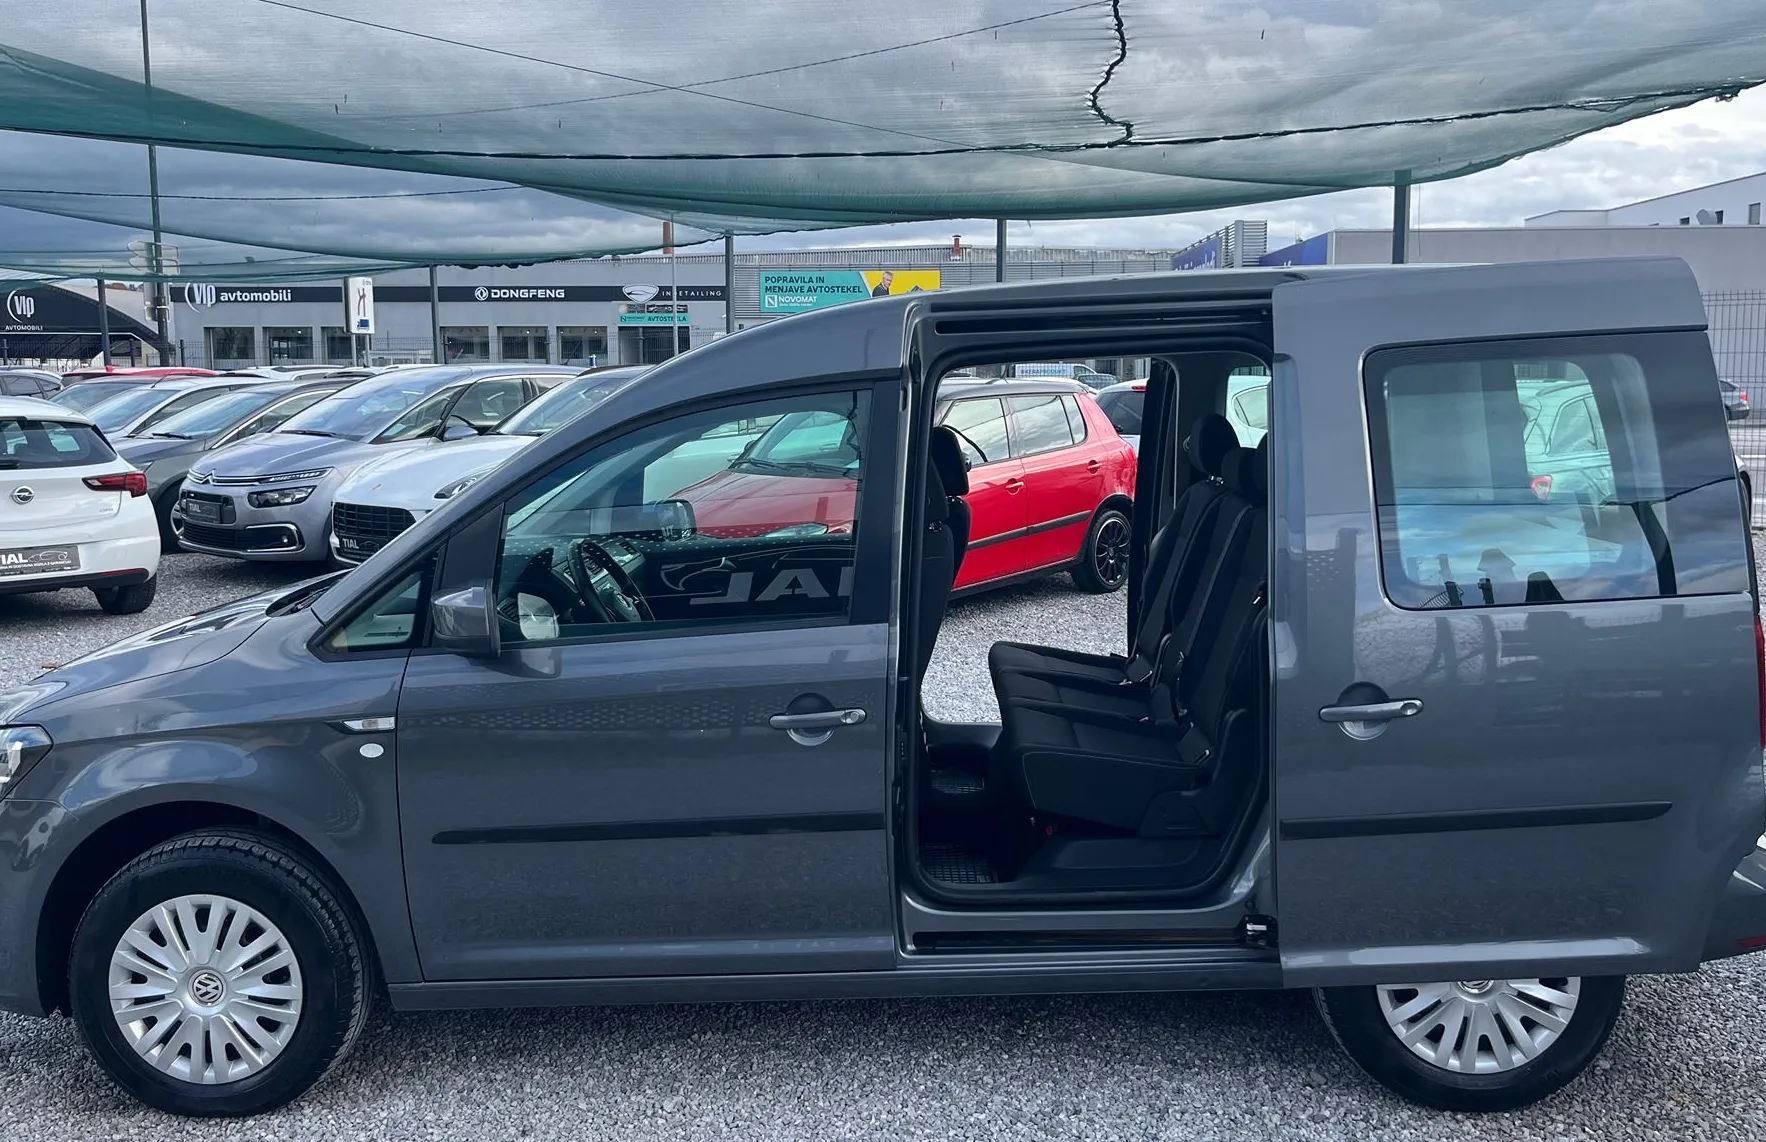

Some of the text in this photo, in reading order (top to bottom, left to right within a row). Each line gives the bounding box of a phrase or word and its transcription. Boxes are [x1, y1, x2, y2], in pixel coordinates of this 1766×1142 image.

[764, 276, 825, 284] POPRAVILA IN
[491, 289, 565, 298] DONGFENG
[764, 285, 863, 293] MENJAVE AVTOSTEKEL
[220, 289, 292, 301] avtomobili
[342, 538, 360, 549] TIAL
[0, 553, 29, 565] IAL
